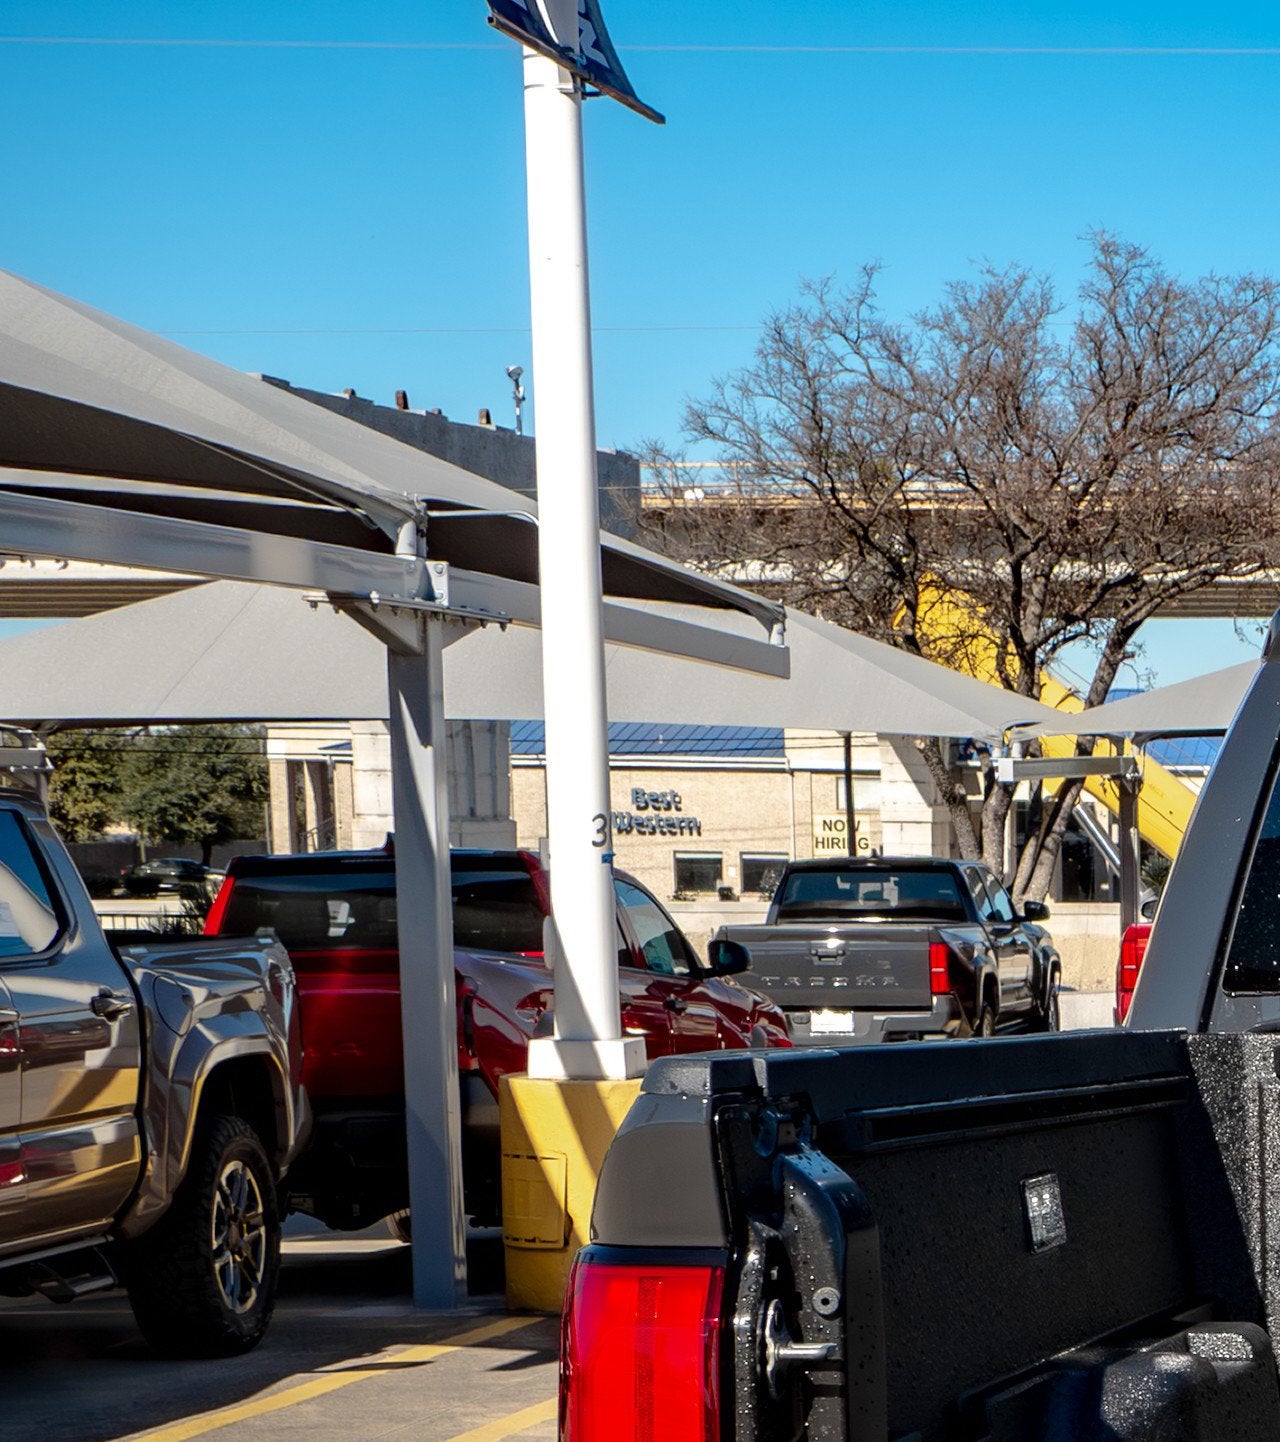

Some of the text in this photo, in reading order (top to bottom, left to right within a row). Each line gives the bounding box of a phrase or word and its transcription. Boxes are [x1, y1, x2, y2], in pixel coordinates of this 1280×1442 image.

[631, 787, 681, 809] Best
[611, 811, 700, 834] Western
[815, 837, 869, 850] HIRIG
